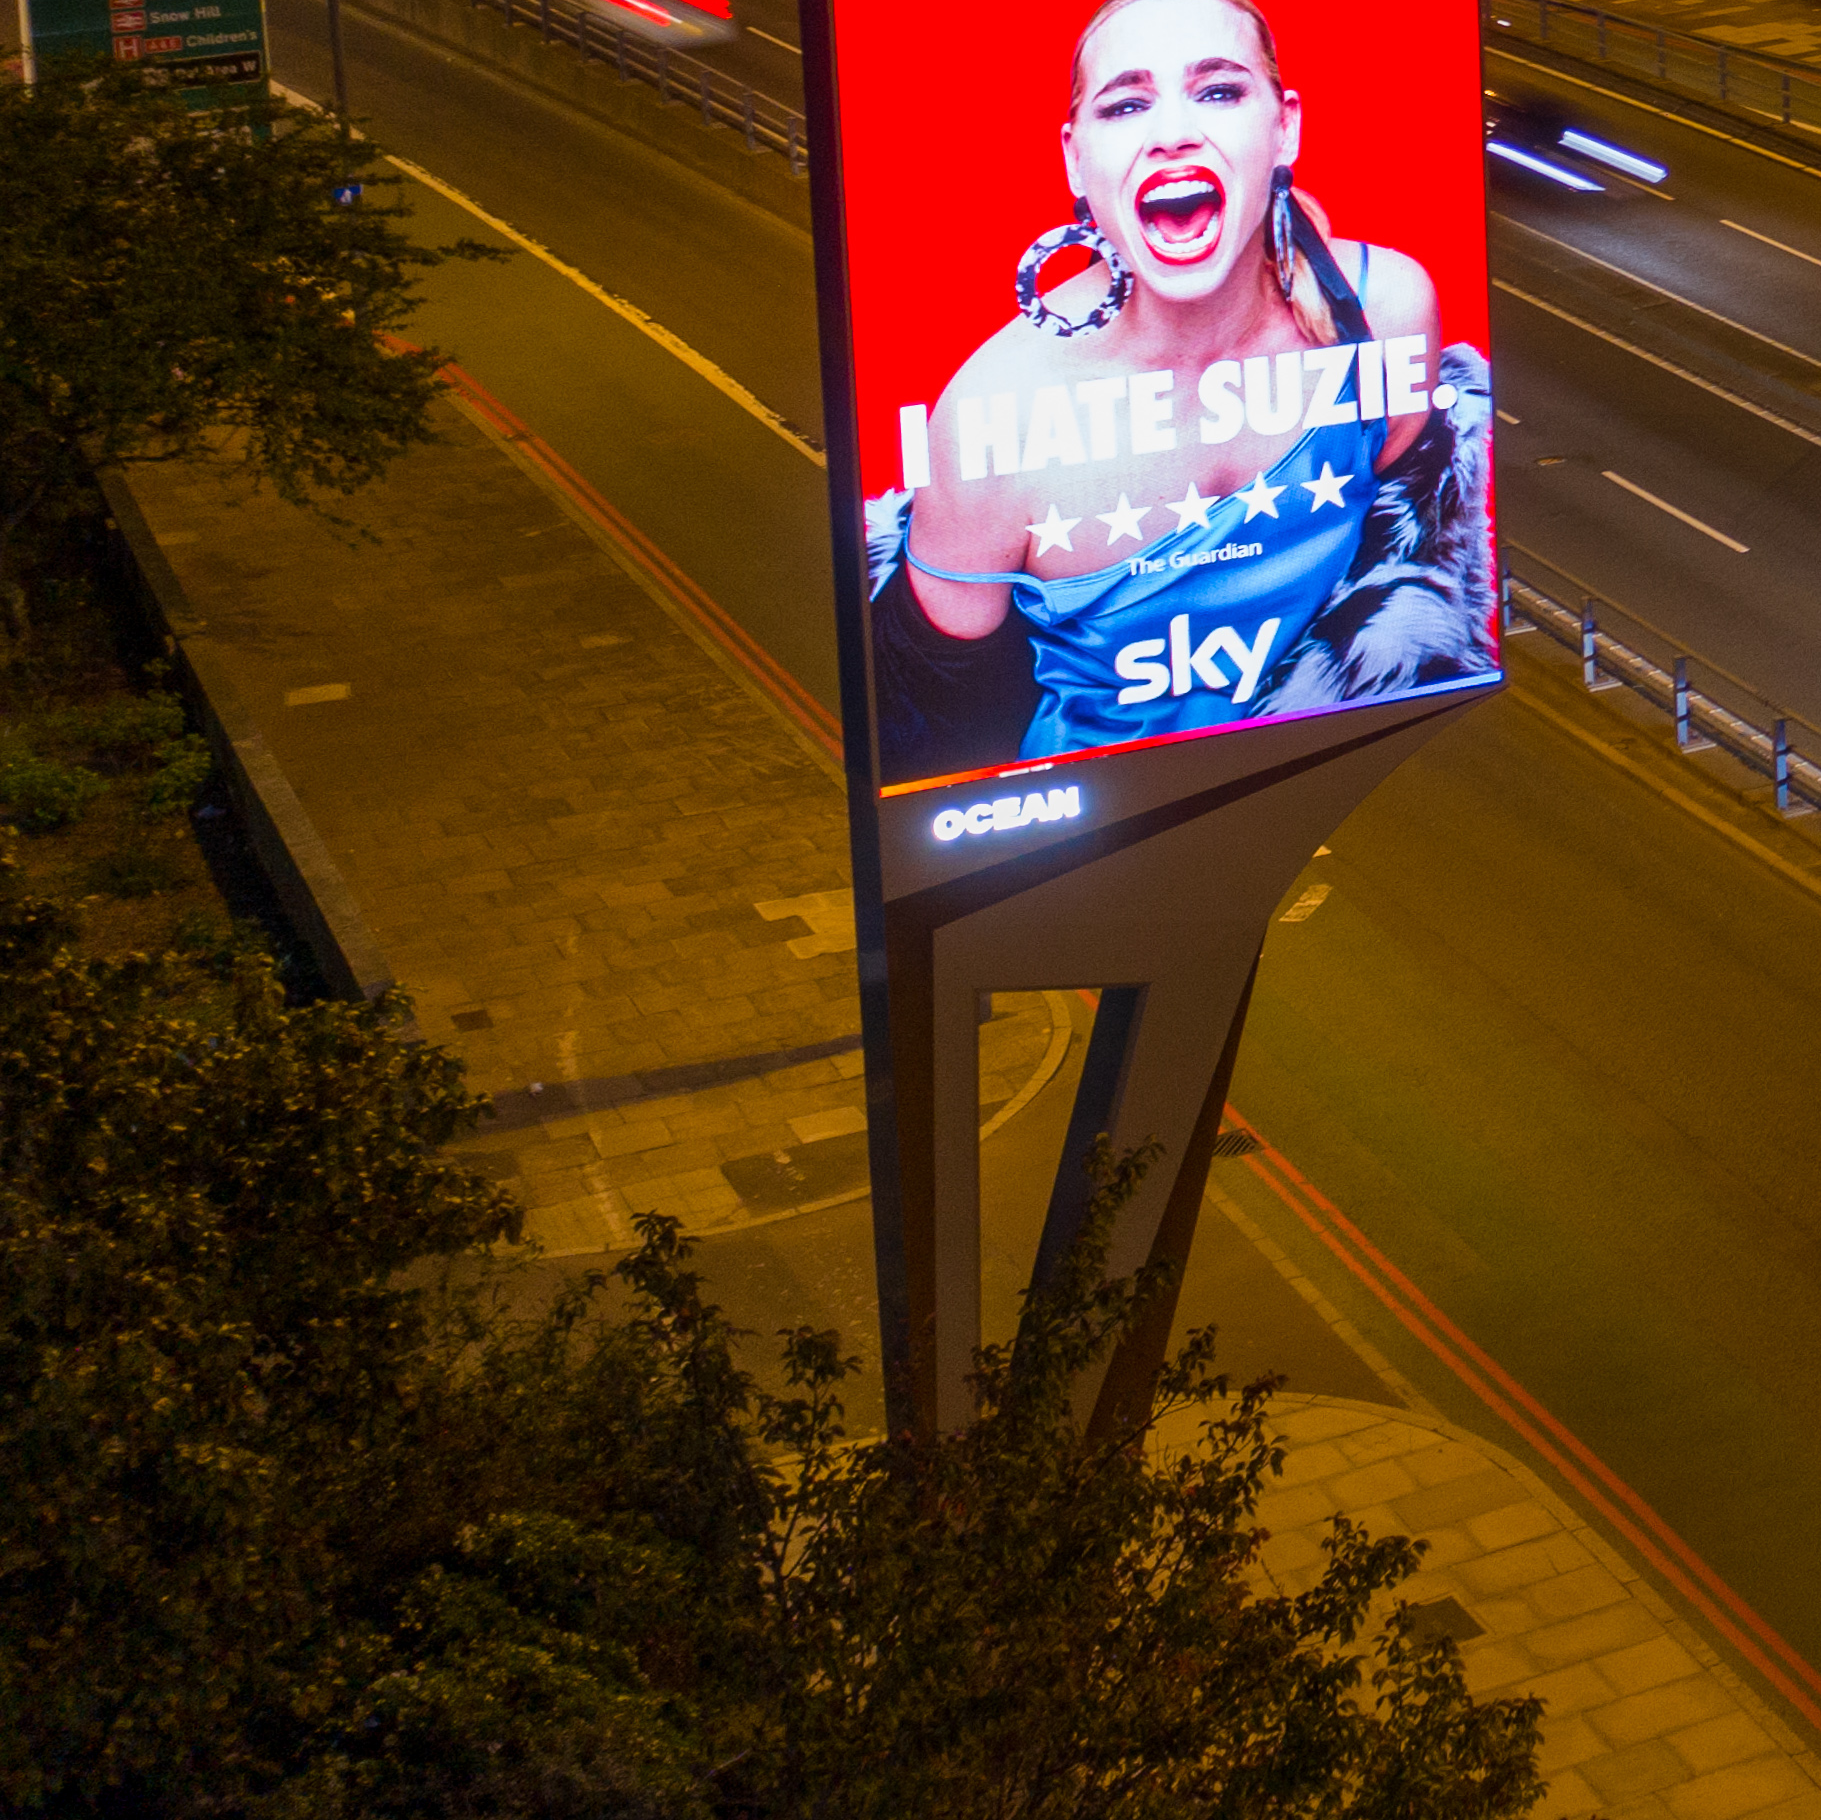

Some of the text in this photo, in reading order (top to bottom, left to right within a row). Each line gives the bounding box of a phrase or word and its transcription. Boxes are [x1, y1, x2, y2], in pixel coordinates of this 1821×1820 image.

[150, 5, 222, 24] Snow Hill
[900, 334, 1457, 489] I HATE SUZIE.
[1126, 542, 1263, 576] The Guardian
[1115, 613, 1281, 705] sky
[933, 786, 1081, 841] OCEAN
